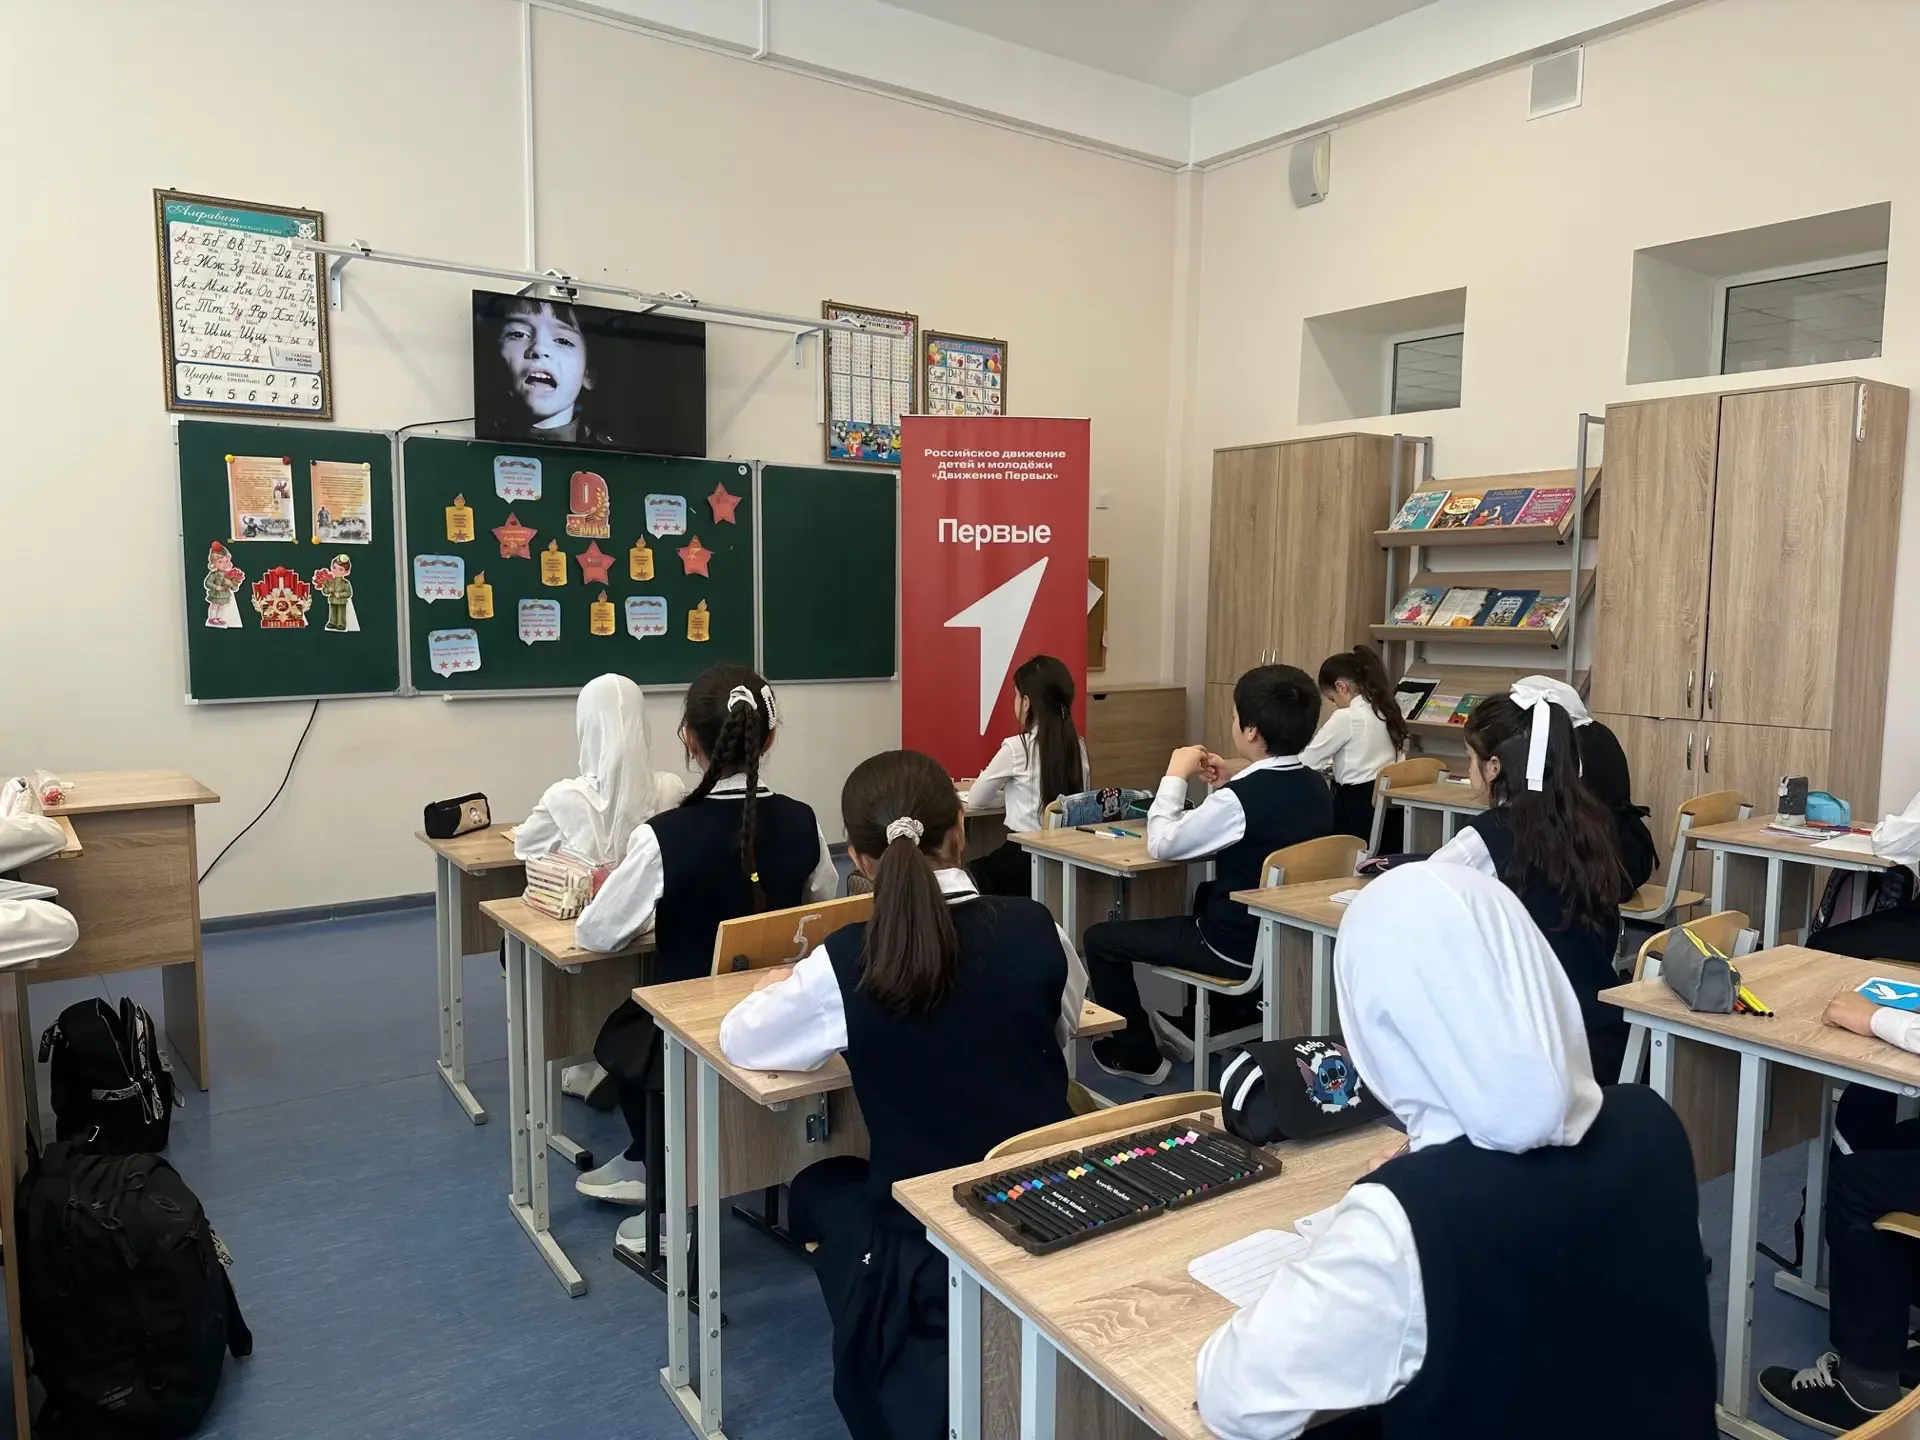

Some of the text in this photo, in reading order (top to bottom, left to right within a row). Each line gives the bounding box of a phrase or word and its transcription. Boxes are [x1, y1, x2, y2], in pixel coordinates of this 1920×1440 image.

[168, 204, 240, 223] Алфавит
[174, 231, 195, 244] Аа
[202, 233, 223, 247] Бб
[227, 237, 245, 250] Вв
[180, 365, 223, 385] Цифры
[266, 374, 319, 389] 0 1 2
[184, 386, 319, 406] 3 4 5 6 7 8 9
[924, 448, 1066, 459] Российское движение
[938, 459, 975, 469] детей
[988, 461, 1053, 470] молодёжи
[932, 471, 1058, 481] «Движение Первых»
[579, 523, 608, 536] МАЯ
[938, 518, 1051, 551] Первые
[783, 913, 822, 963] 5
[1294, 1040, 1325, 1056] Hello
